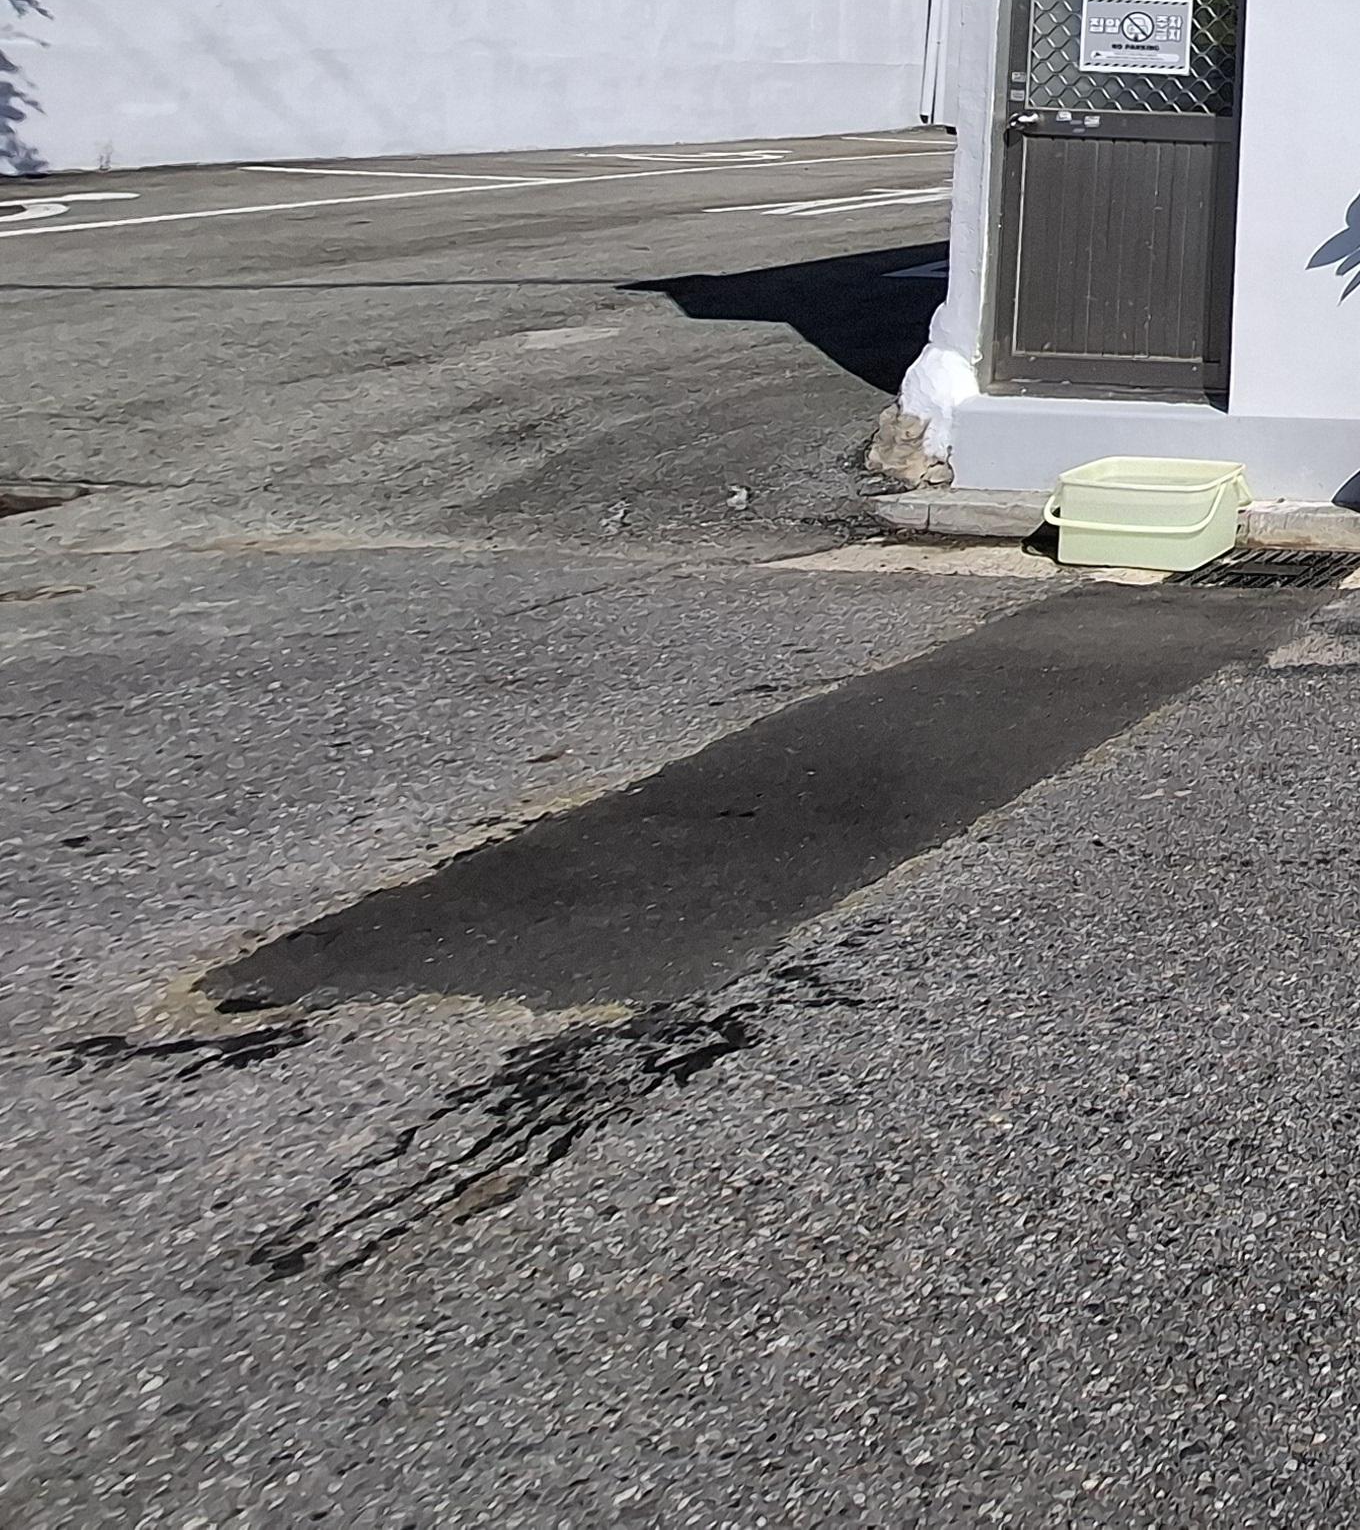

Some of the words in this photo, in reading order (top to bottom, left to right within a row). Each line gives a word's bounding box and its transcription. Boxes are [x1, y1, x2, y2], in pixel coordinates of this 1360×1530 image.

[1156, 15, 1183, 29] 주차
[1155, 27, 1182, 41] 금지
[1125, 43, 1160, 51] PARKING
